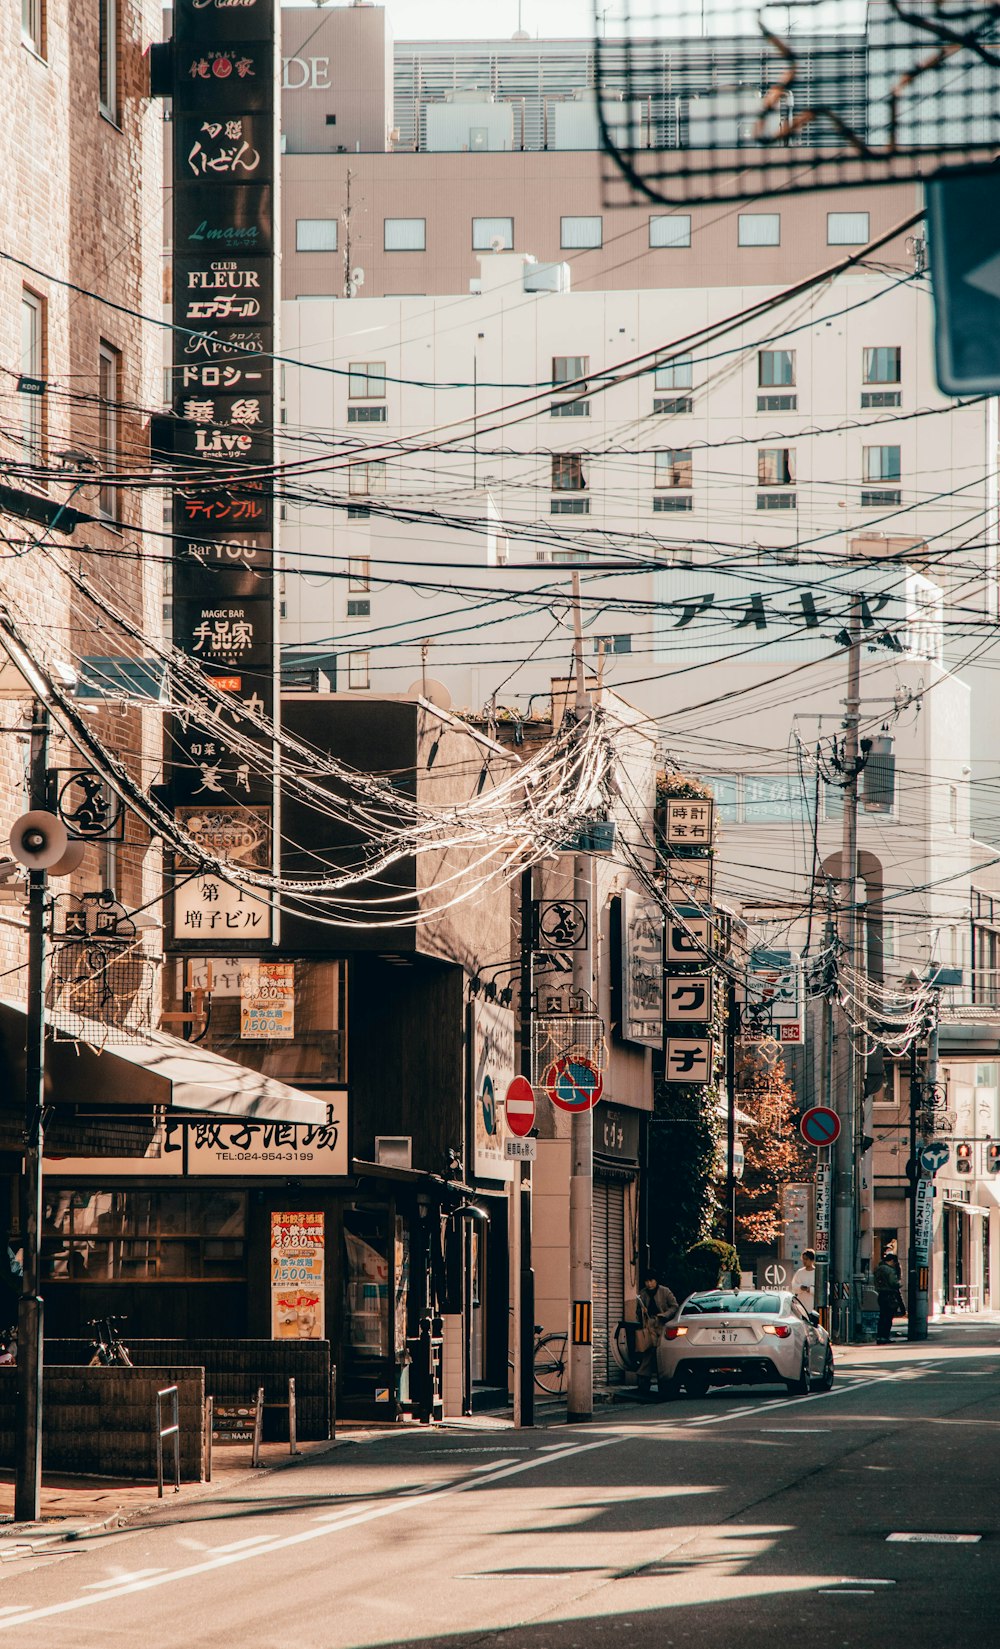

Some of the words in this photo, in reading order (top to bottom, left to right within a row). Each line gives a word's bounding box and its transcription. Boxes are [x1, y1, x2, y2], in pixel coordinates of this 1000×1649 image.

[282, 57, 332, 89] DE
[210, 261, 237, 271] CLUB
[187, 271, 260, 288] FLEUR
[184, 330, 263, 356] Kronos
[183, 366, 262, 388] ドロシー
[22, 383, 40, 391] KDDI
[195, 430, 252, 450] Live
[188, 543, 211, 555] Bar
[213, 540, 256, 558] YOU
[201, 610, 227, 618] MAGIC
[228, 610, 244, 618] BAR
[192, 620, 253, 651] 手品家
[672, 808, 706, 820] 時計
[672, 824, 706, 837] 宝石
[67, 914, 116, 932] 大町
[184, 910, 263, 929] 増子ビル
[216, 1152, 313, 1161] TEL:024-954-3199
